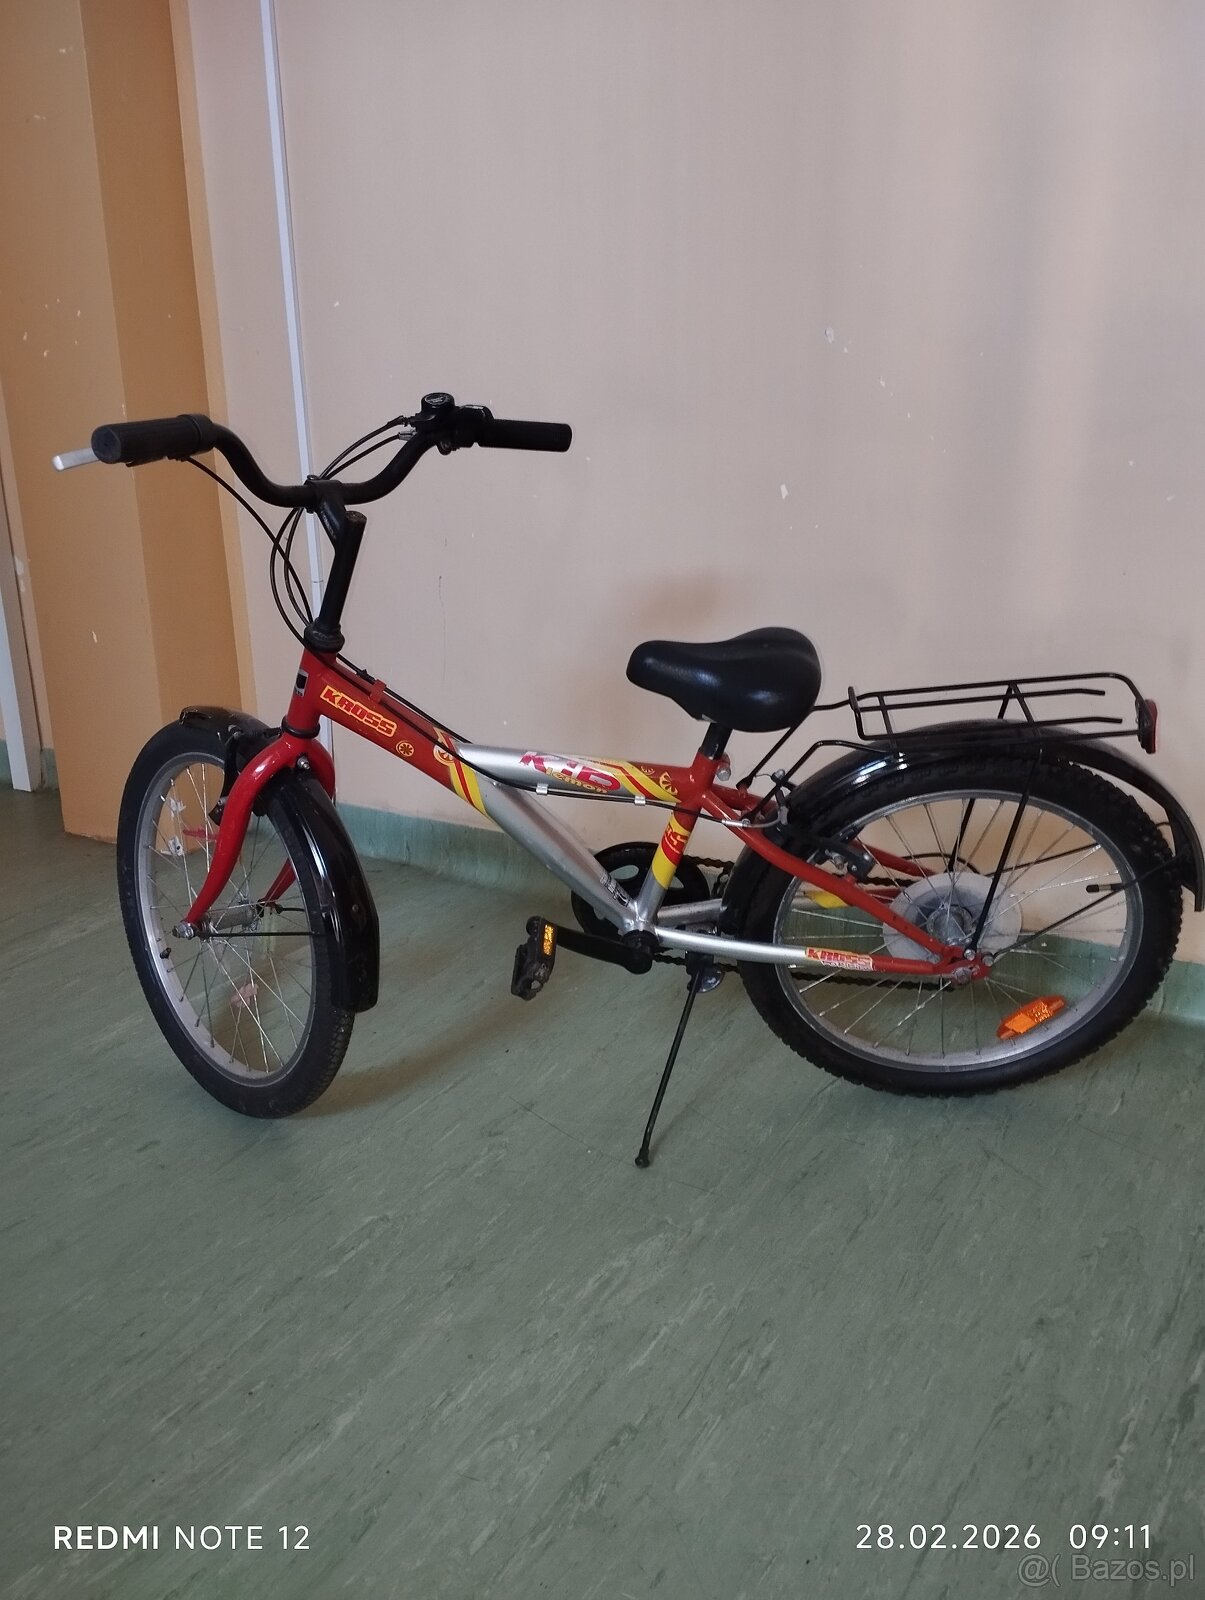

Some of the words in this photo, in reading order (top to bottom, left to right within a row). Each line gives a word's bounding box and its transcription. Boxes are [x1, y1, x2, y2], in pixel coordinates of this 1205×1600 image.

[320, 685, 397, 737] KROSS
[519, 751, 621, 790] KID
[545, 767, 608, 794] lemon
